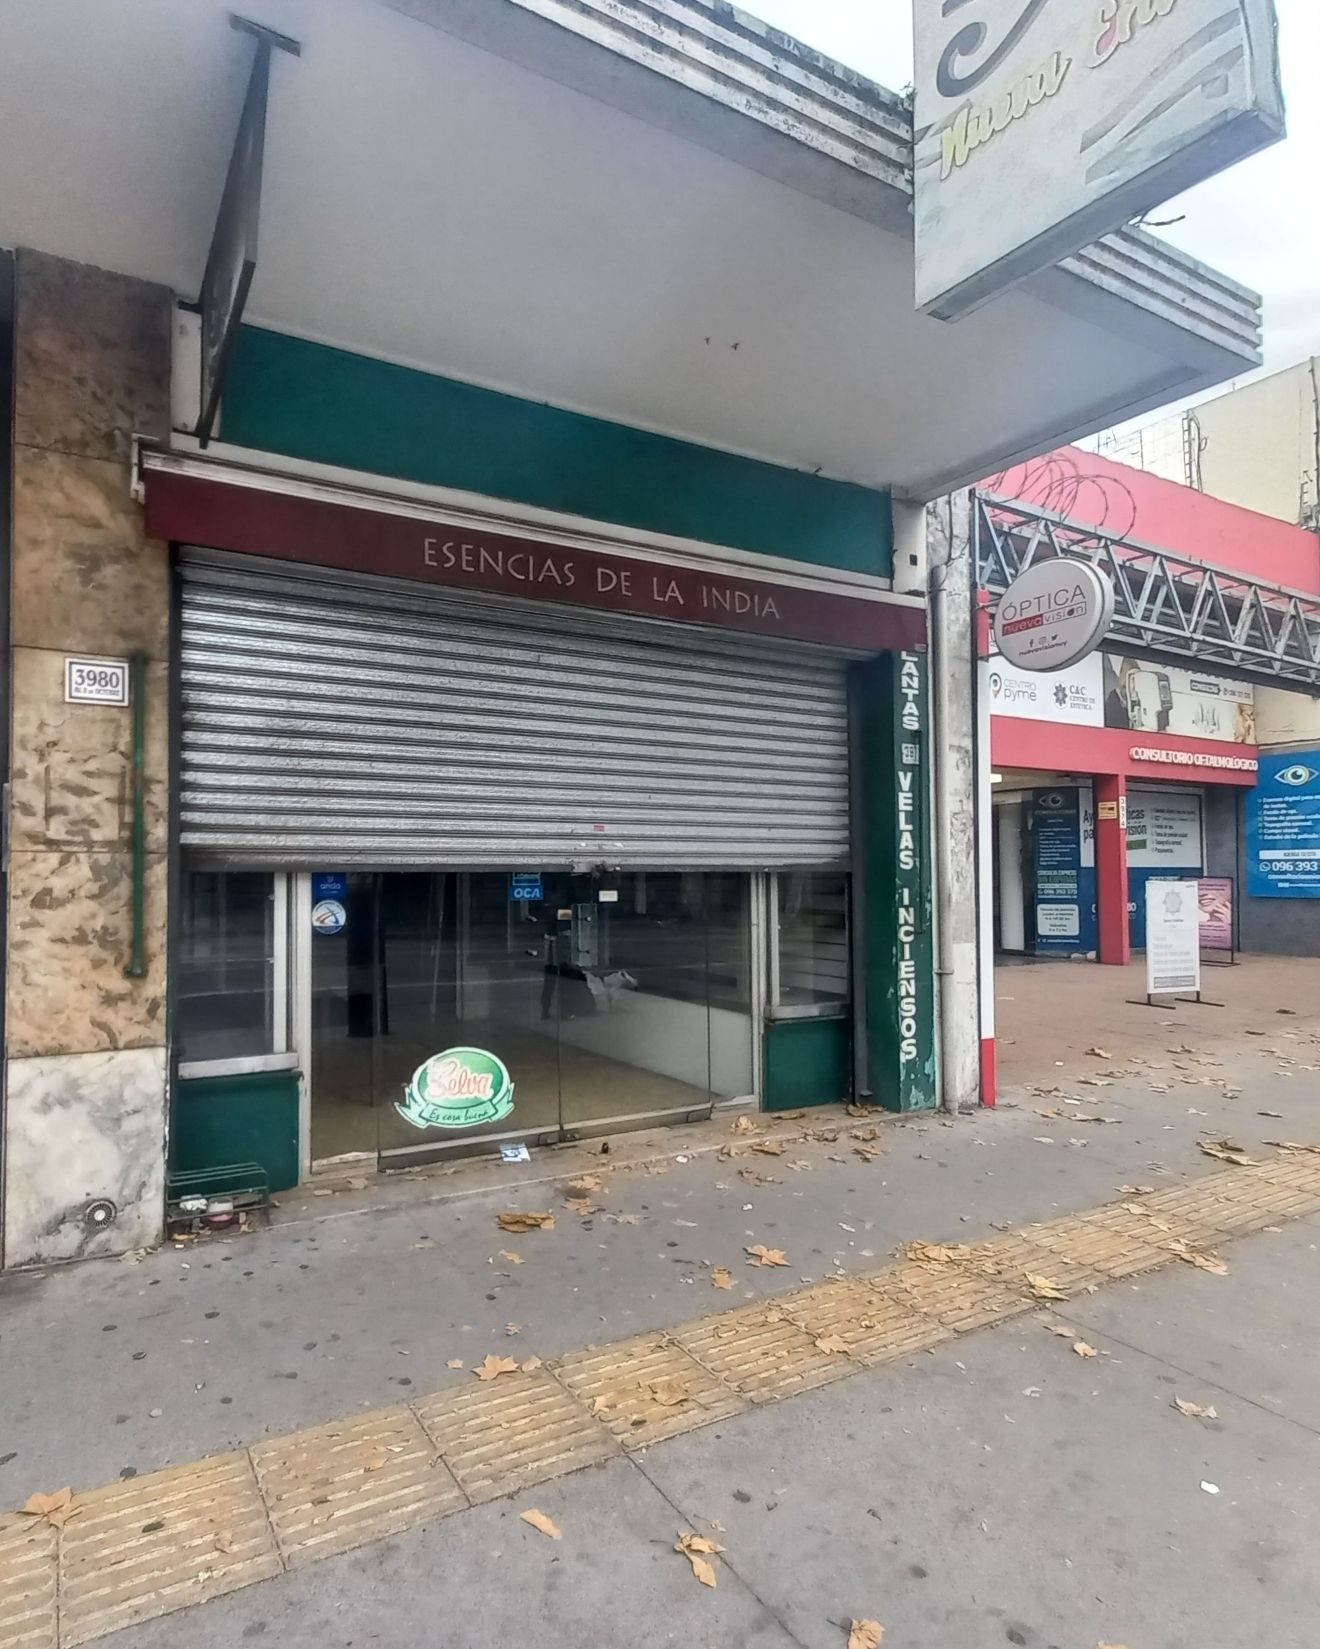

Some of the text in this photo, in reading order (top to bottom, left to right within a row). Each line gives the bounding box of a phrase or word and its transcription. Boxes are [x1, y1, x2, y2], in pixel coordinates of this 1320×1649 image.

[424, 538, 780, 619] ESENCIAS DE LA INDIA
[1002, 584, 1086, 621] ÓPTICA
[74, 668, 120, 689] 3980
[1004, 688, 1037, 702] pyme
[1131, 747, 1193, 765] CONSULTORIO
[898, 771, 914, 870] VELAS
[1272, 861, 1318, 872] 096 393
[514, 887, 540, 899] OCA
[898, 887, 917, 1061] INCIENSOS
